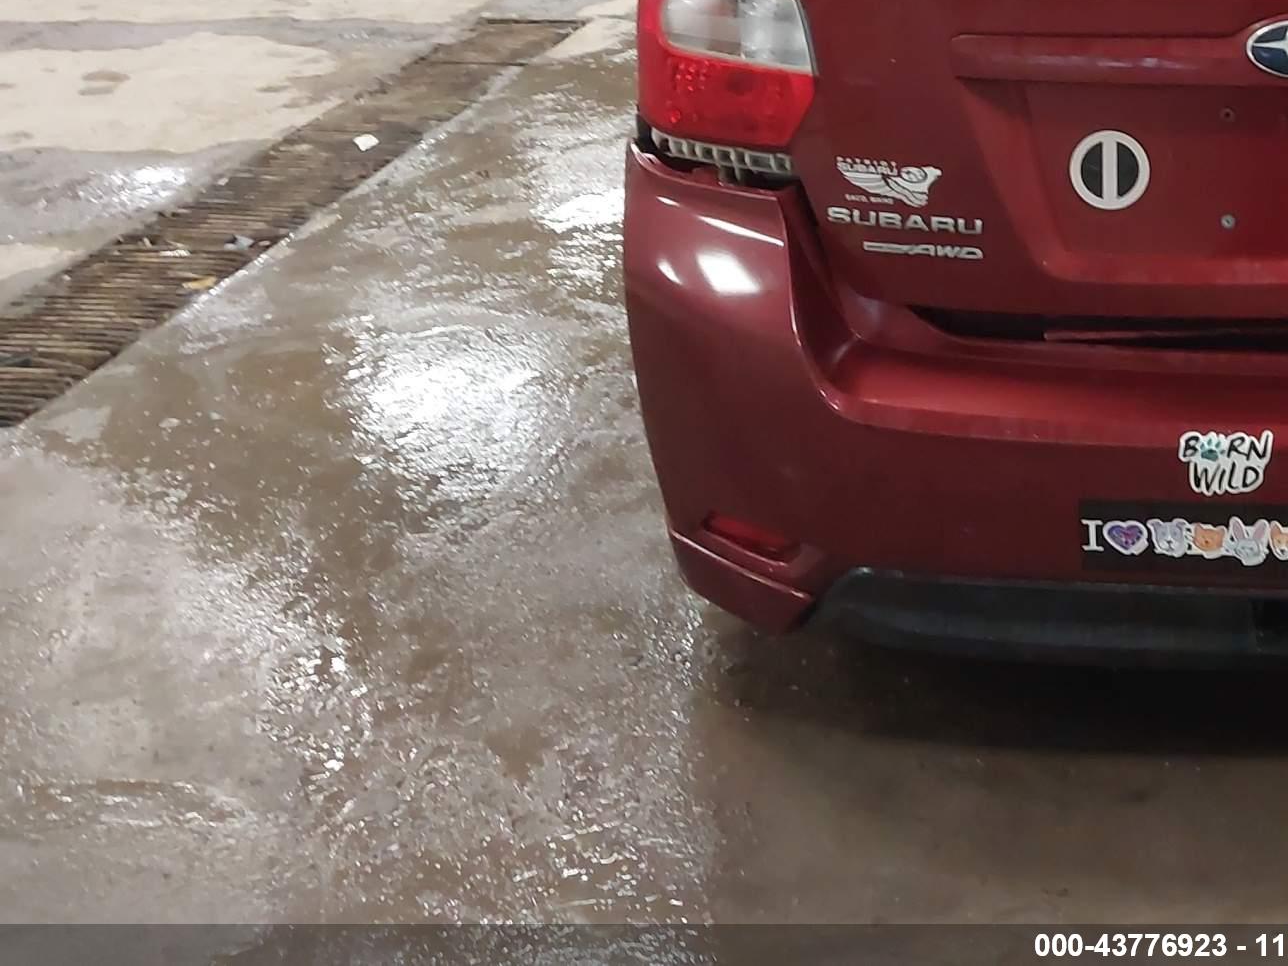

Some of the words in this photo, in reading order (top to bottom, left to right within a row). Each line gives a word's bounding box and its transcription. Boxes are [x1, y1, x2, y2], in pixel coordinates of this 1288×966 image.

[836, 161, 898, 177] SUBARU
[826, 205, 983, 235] SUBARU
[909, 243, 984, 260] AWD
[1192, 460, 1260, 492] WILD
[1080, 518, 1104, 552] I
